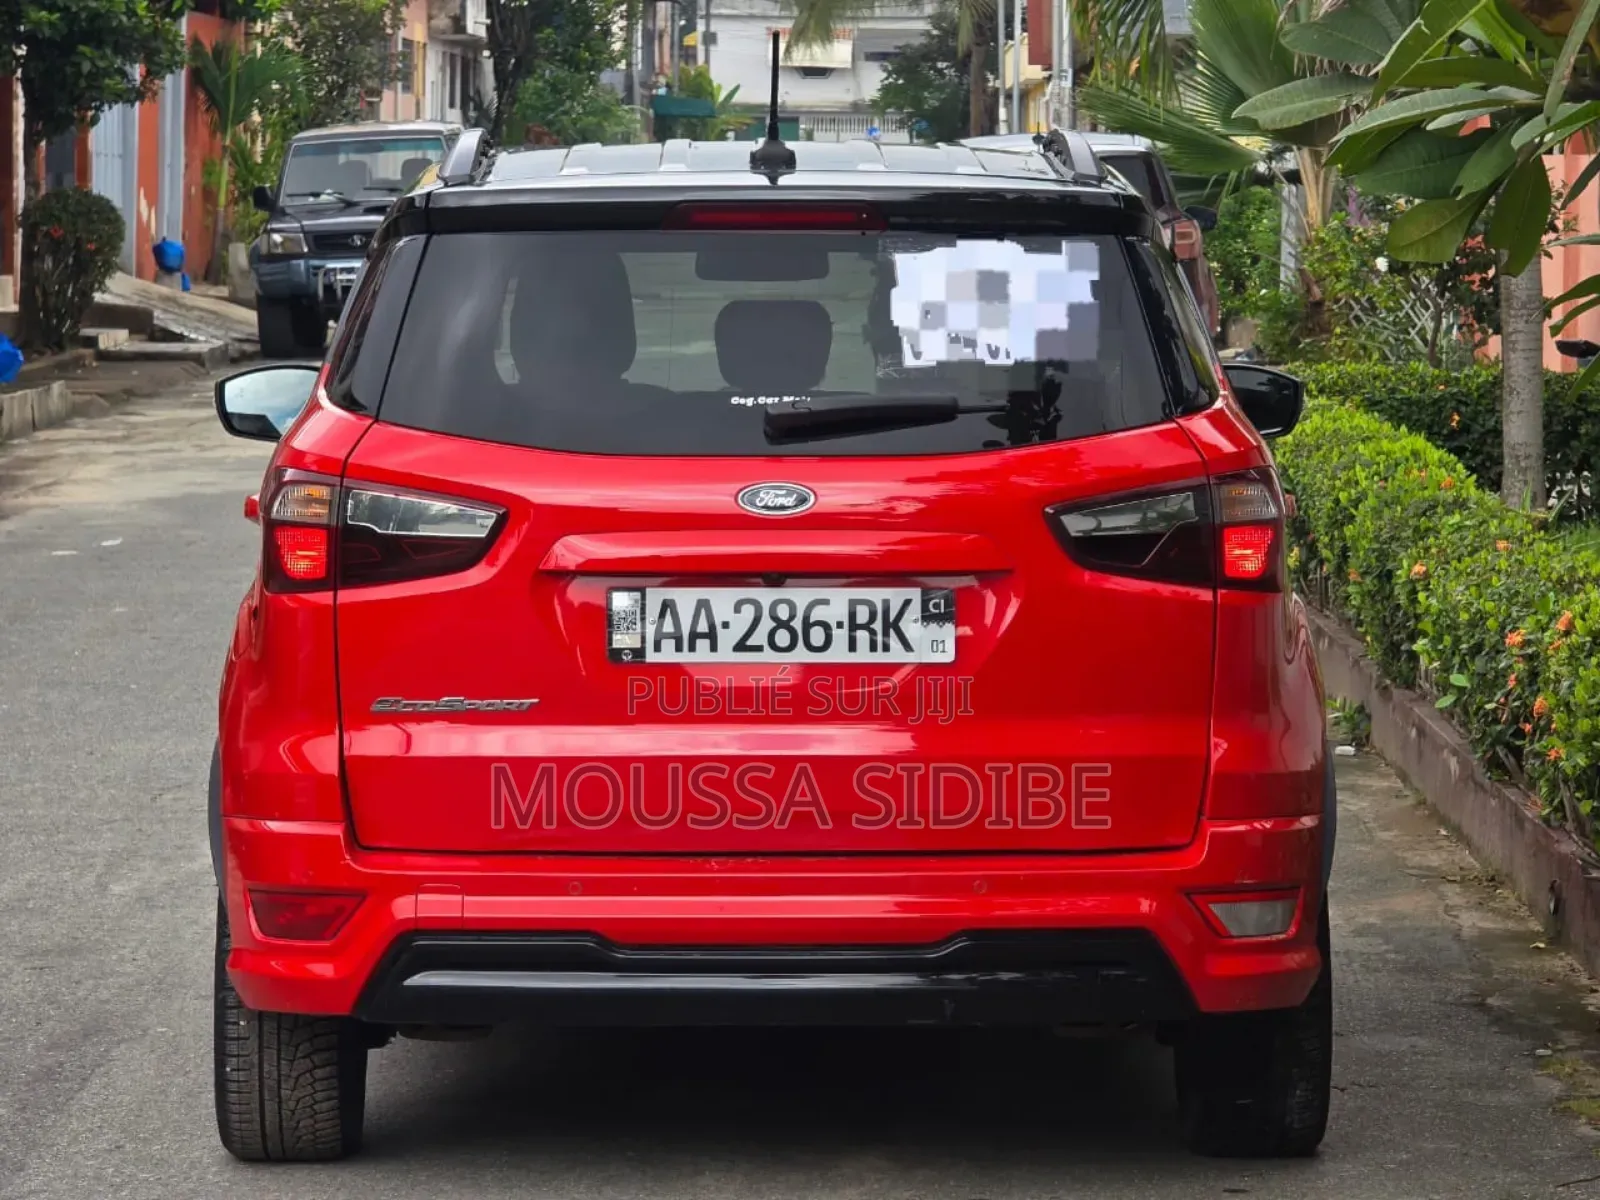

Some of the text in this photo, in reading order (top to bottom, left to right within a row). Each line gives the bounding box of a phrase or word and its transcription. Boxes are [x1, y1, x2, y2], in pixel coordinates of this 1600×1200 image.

[756, 489, 797, 507] Ford
[929, 599, 945, 613] CI
[931, 639, 948, 653] 01
